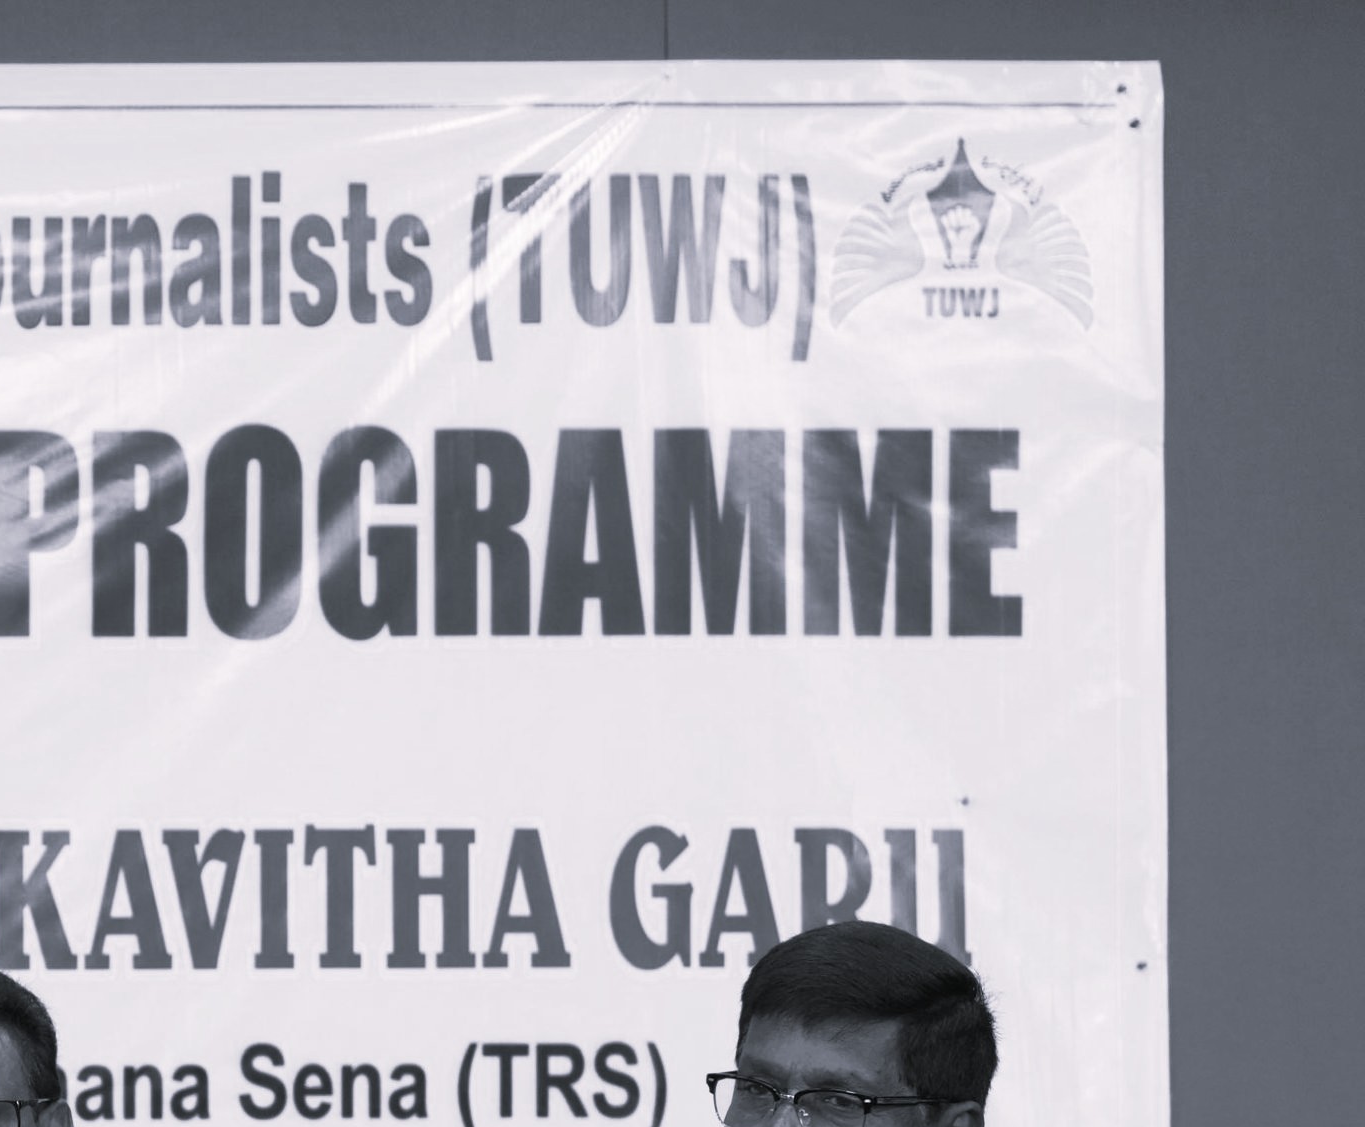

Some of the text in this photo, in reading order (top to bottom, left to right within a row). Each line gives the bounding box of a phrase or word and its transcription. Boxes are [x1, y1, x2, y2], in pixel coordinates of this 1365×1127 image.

[469, 172, 818, 362] (TUWJ)
[922, 287, 1000, 319] TUWJ
[609, 825, 972, 970] GARU
[57, 1063, 211, 1122] ana
[238, 1042, 429, 1121] Sena
